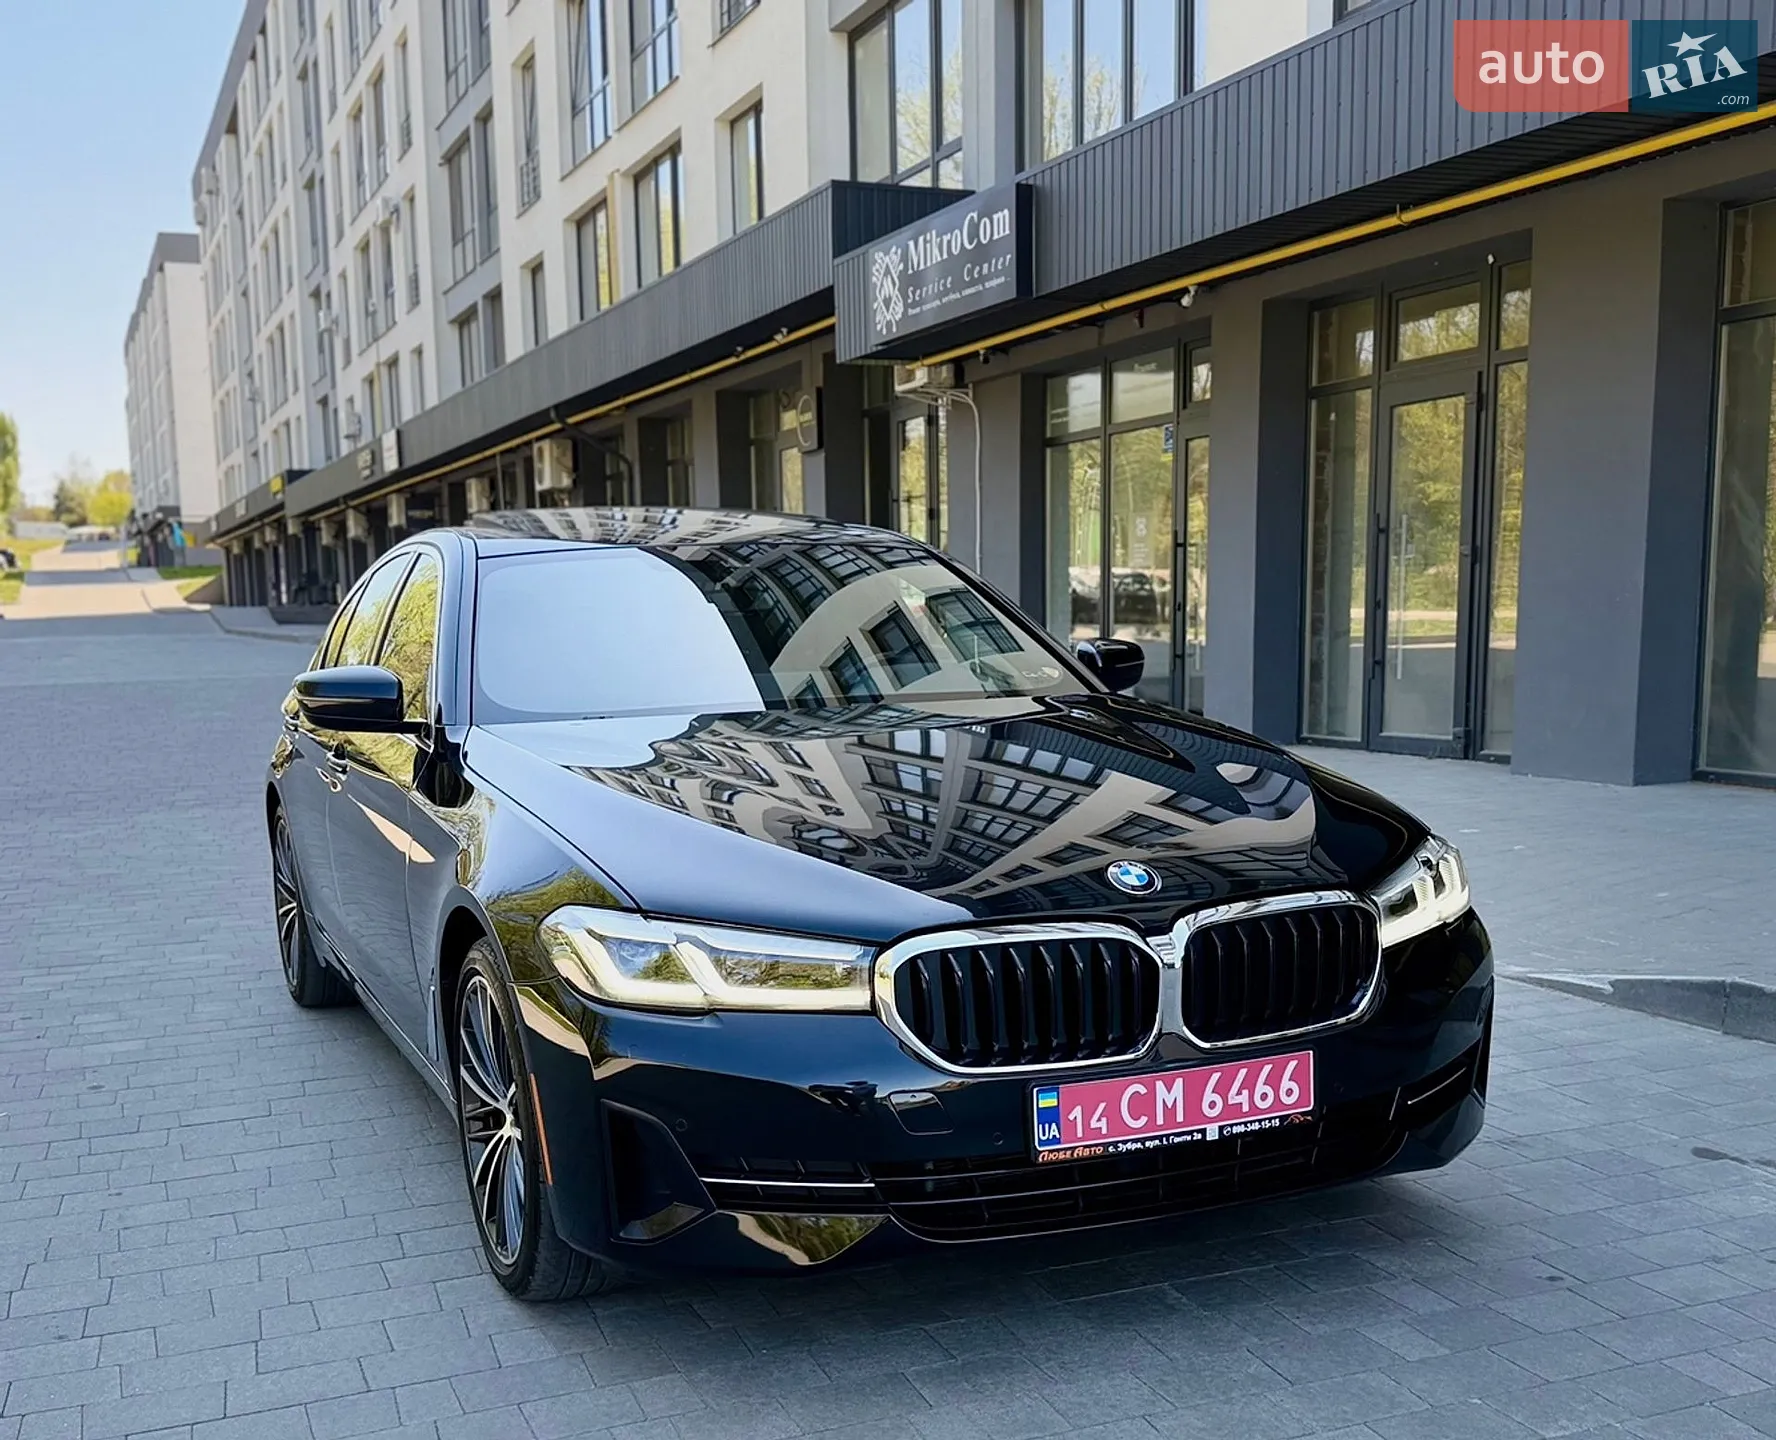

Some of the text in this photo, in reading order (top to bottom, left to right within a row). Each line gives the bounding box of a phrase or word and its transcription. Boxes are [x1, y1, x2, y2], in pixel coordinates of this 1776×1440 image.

[907, 208, 1010, 275] MikroCom
[907, 275, 952, 304] Service
[963, 253, 1012, 282] Center
[1068, 1102, 1108, 1139] 14
[1201, 1060, 1299, 1118] 6466
[1039, 1123, 1060, 1140] UA
